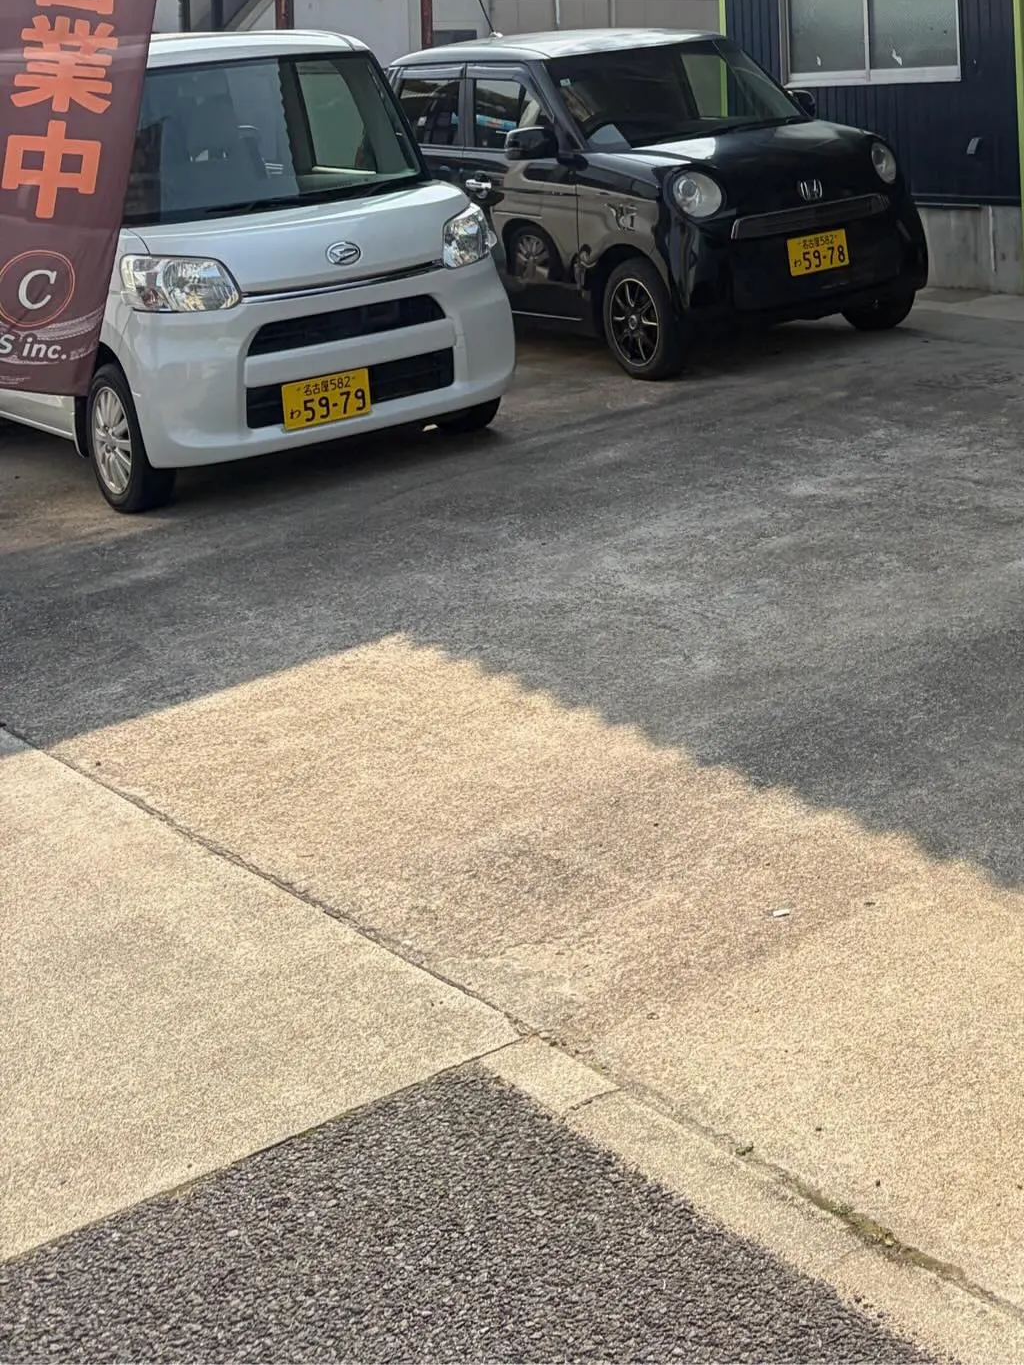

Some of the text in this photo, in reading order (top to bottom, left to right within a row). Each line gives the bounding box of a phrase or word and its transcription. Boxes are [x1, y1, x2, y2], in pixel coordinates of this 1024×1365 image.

[803, 245, 845, 270] 59-78
[18, 269, 57, 310] C
[22, 337, 67, 360] inc.
[303, 388, 366, 422] 59-79
